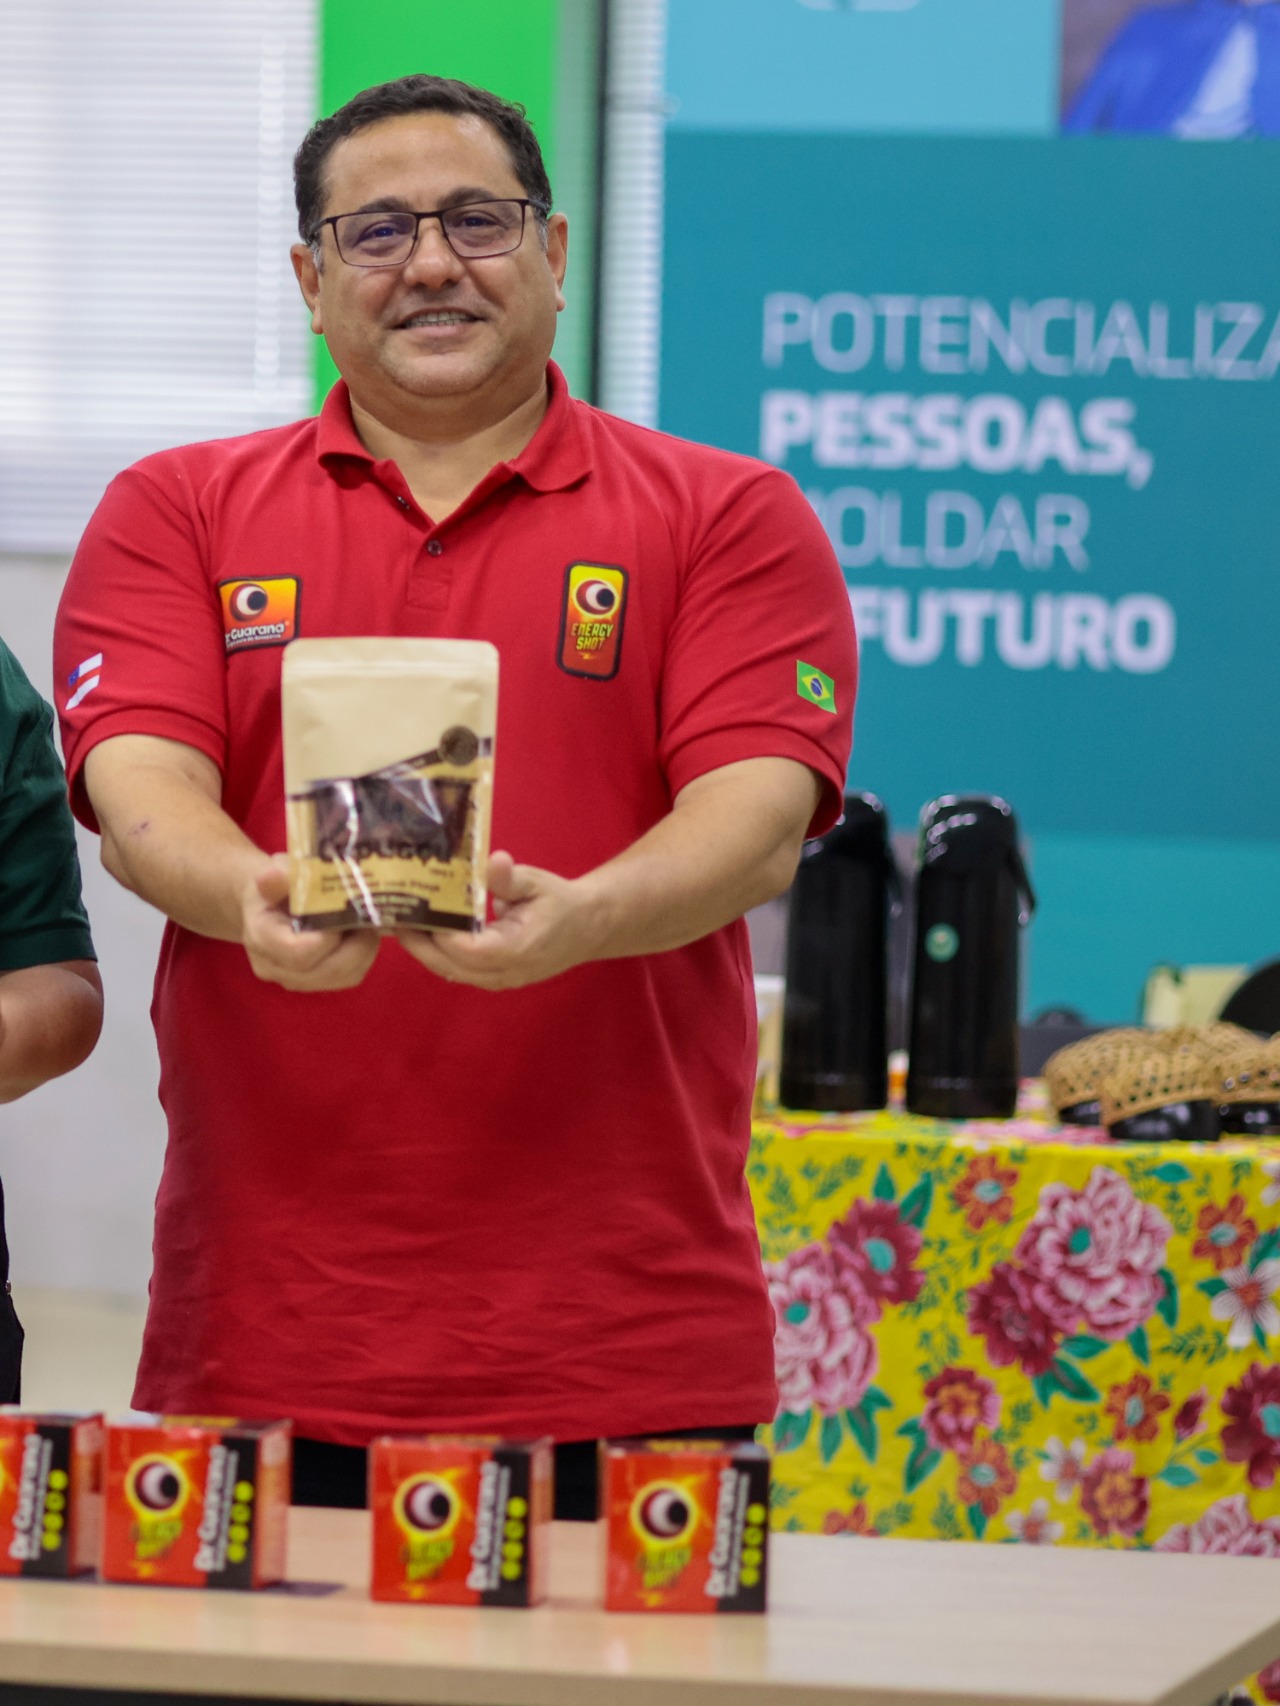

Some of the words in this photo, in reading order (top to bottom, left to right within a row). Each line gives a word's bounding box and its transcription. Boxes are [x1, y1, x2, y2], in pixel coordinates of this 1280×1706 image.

[760, 389, 1154, 491] PESSOAS,
[804, 486, 1090, 573] OLDAR
[571, 622, 614, 638] ENERGY
[576, 636, 606, 651] SHOT
[849, 585, 1176, 674] FUTURO
